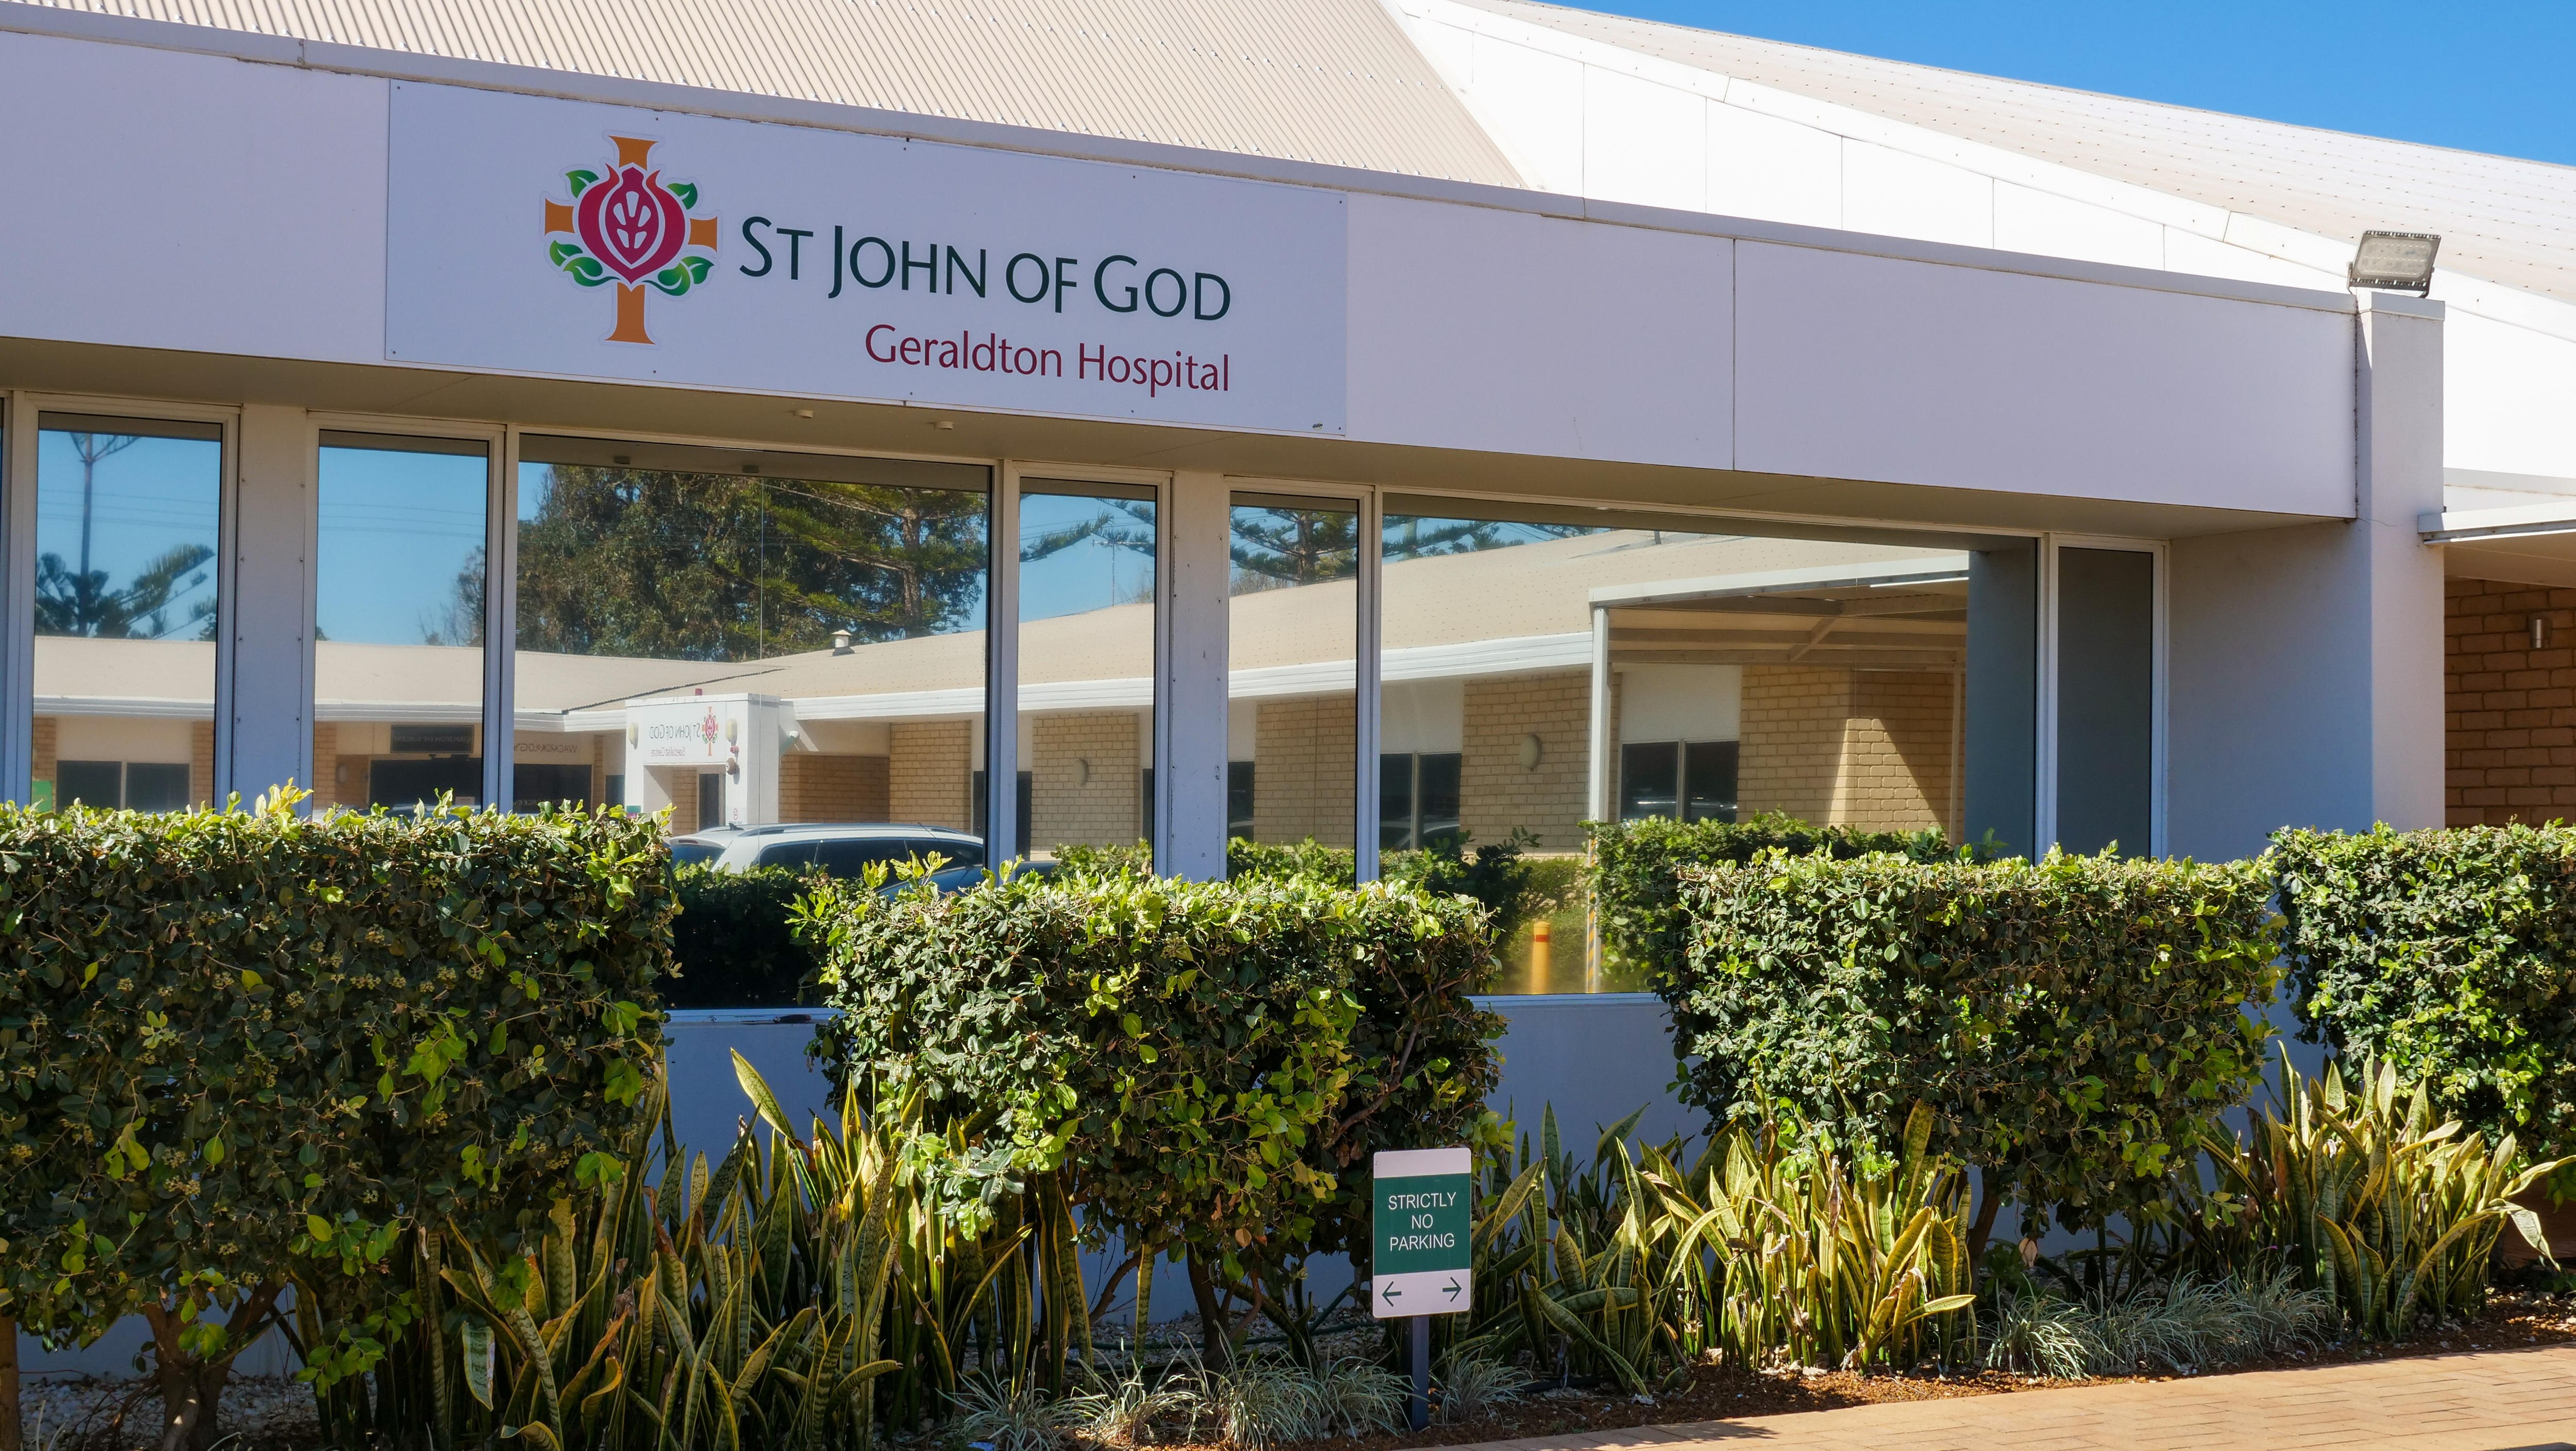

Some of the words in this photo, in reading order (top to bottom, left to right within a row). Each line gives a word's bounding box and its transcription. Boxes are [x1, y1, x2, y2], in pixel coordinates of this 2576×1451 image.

[739, 216, 814, 280] ST
[828, 225, 986, 299] JOHN
[1006, 252, 1078, 314] OF
[1094, 255, 1231, 321] GOD
[865, 324, 1062, 377] Geraldton
[1079, 343, 1228, 398] Hospital
[1388, 1192, 1456, 1210] STRICTLY
[1412, 1213, 1433, 1229] NO
[1390, 1233, 1454, 1252] PARKING
